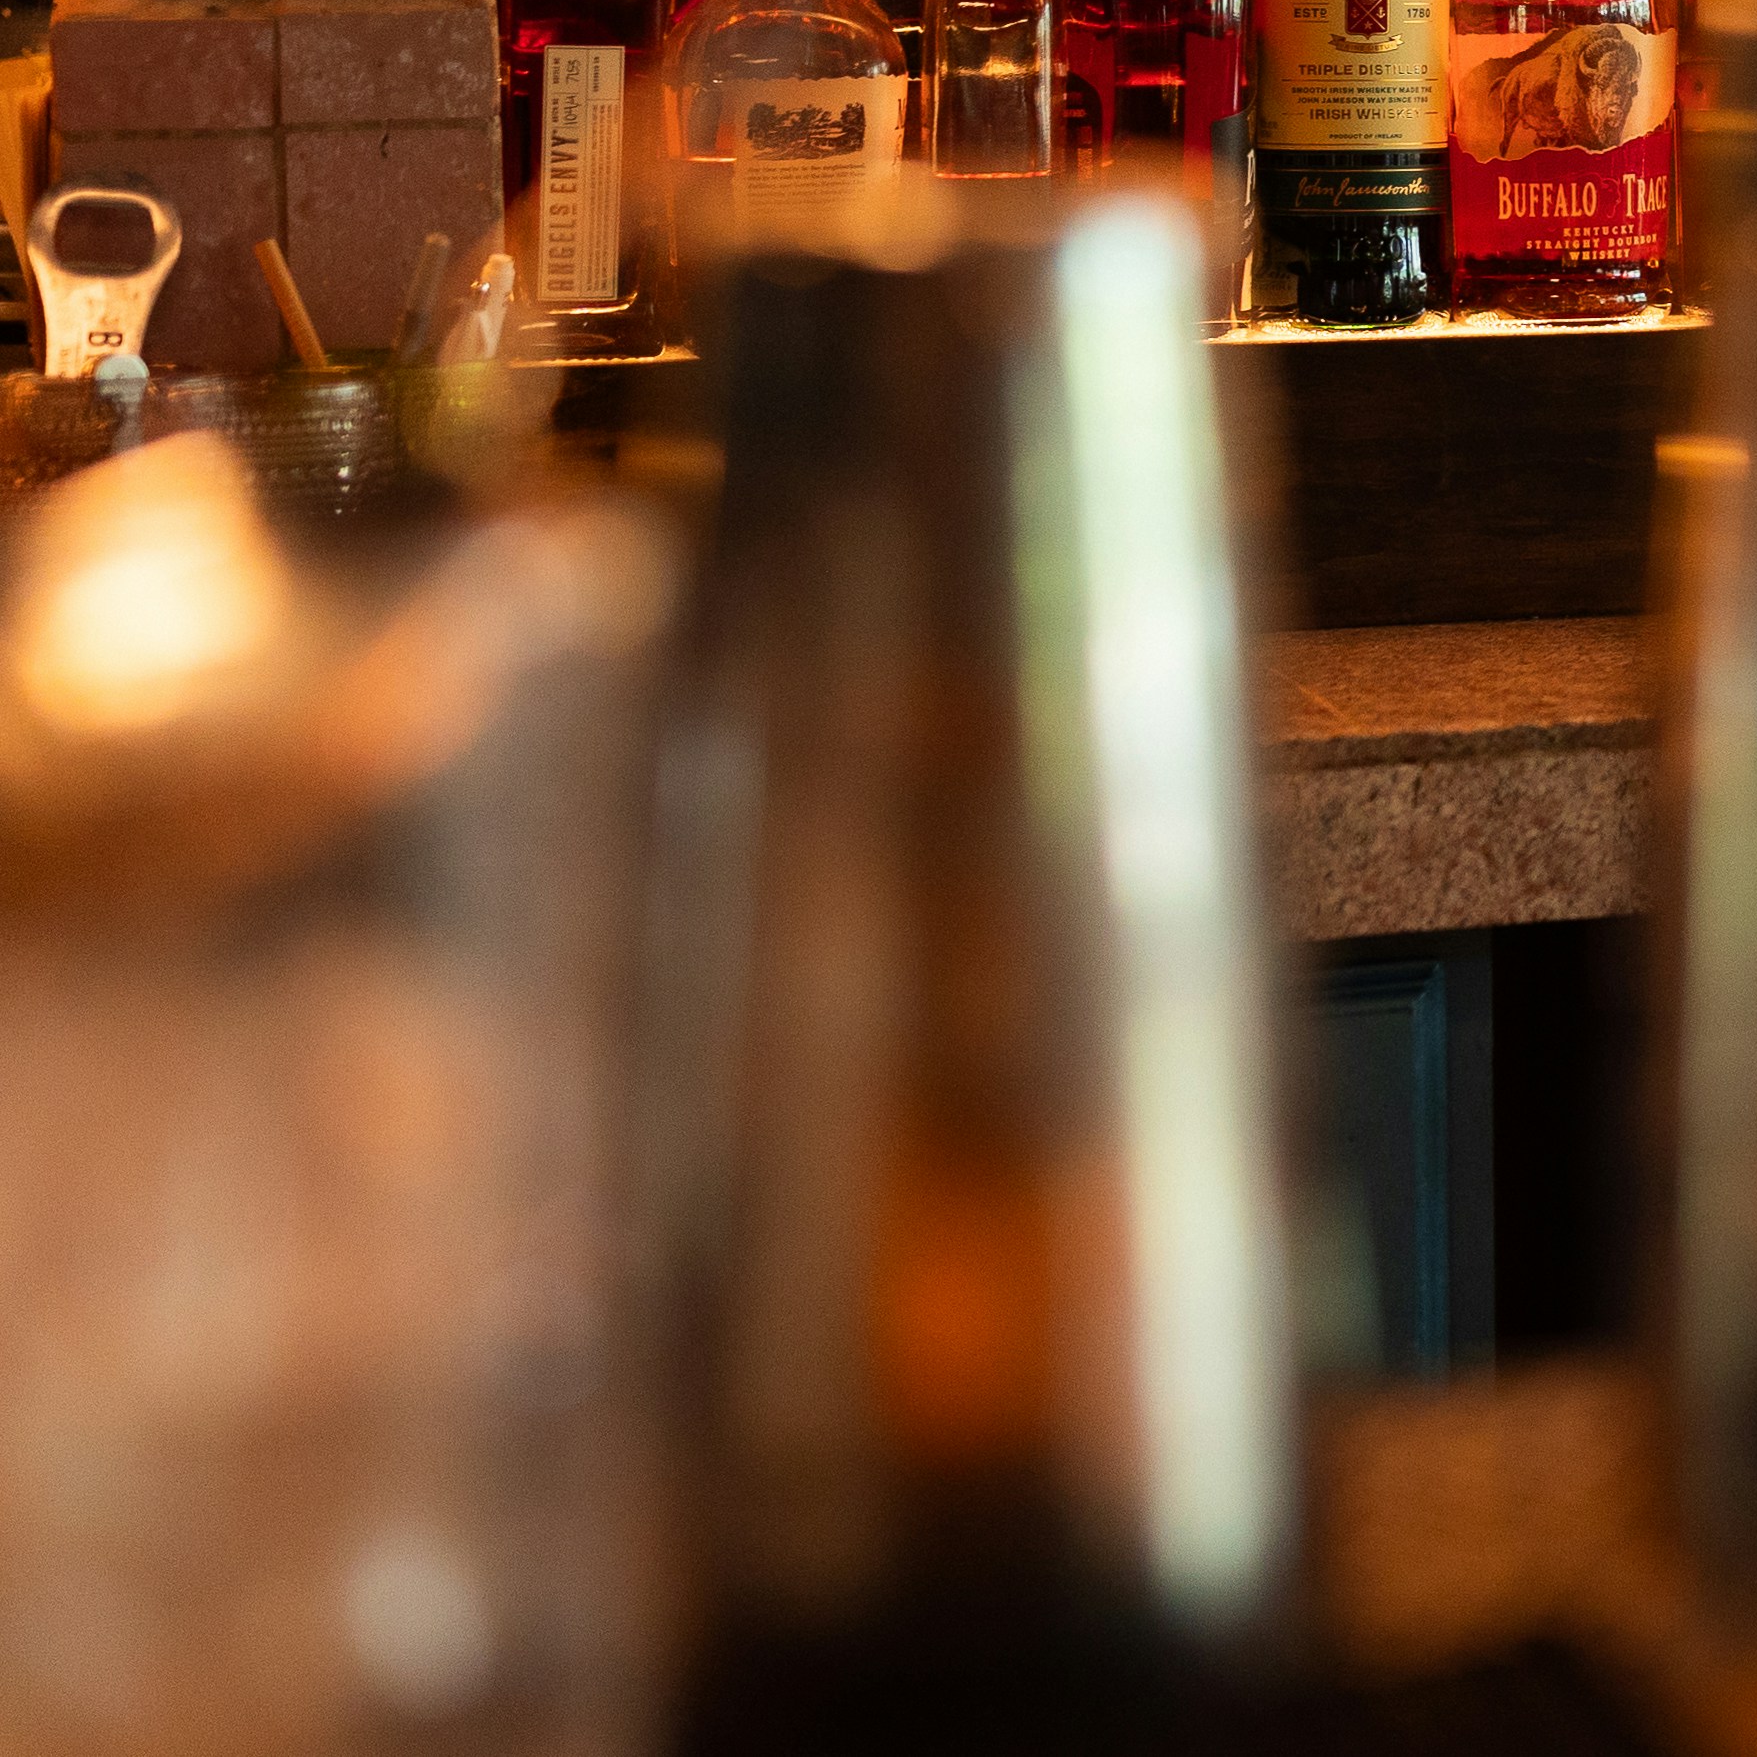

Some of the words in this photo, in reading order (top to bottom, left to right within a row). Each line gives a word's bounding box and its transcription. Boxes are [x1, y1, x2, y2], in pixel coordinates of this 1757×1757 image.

[1407, 8, 1431, 19] 1780
[1298, 65, 1353, 76] TRIPLE
[1359, 64, 1428, 76] DISTILLED
[1310, 109, 1351, 120] IRISH
[1357, 108, 1421, 120] WHISKEY
[550, 134, 579, 193] ENVY
[1498, 176, 1597, 219] BUFFALO
[1622, 173, 1667, 218] TRACE
[1563, 224, 1635, 237] KENTUCKY
[1526, 238, 1599, 250] STRAIGHT
[1608, 233, 1657, 248] BOURBON
[1569, 248, 1631, 260] WHISKEY
